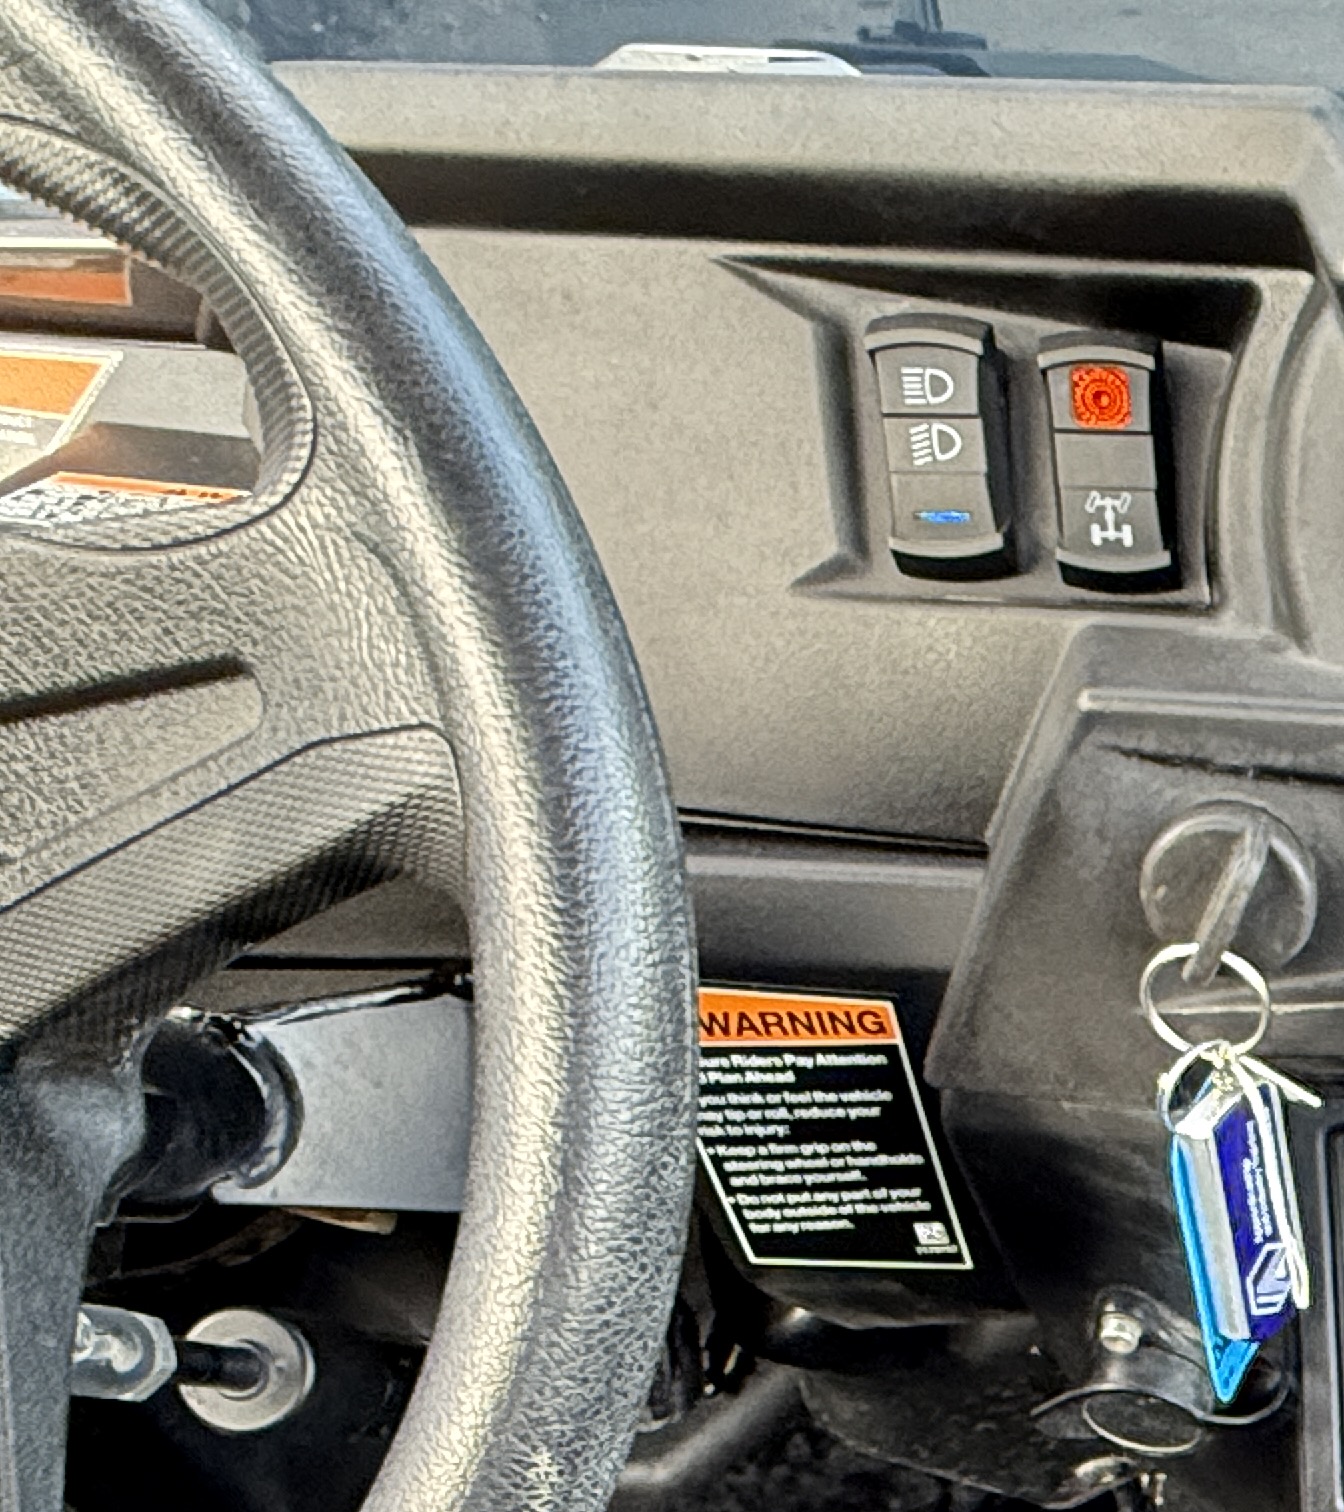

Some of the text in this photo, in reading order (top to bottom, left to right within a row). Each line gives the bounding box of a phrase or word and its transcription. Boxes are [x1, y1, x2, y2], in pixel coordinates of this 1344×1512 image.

[700, 1010, 888, 1037] WARNING
[730, 1054, 784, 1068] Riders
[783, 1053, 814, 1069] Pay
[816, 1052, 888, 1066] Attention
[707, 1071, 743, 1085] Plan
[744, 1070, 796, 1083] Ahead
[726, 1091, 765, 1104] think
[766, 1094, 782, 1104] or
[783, 1091, 812, 1104] feel
[812, 1090, 838, 1102] the
[838, 1089, 893, 1102] vehicle
[794, 1106, 846, 1119] reduce
[847, 1107, 881, 1121] your
[715, 1144, 755, 1157] Keep
[768, 1142, 799, 1154] firm
[800, 1141, 829, 1155] grip
[831, 1142, 850, 1152] on
[851, 1140, 877, 1152] the
[723, 1158, 784, 1171] steering
[785, 1157, 829, 1169] wheel
[846, 1153, 925, 1166] handholds
[729, 1174, 759, 1187] and
[759, 1173, 802, 1185] brace
[736, 1193, 759, 1205] Do
[760, 1192, 785, 1204] not
[786, 1191, 812, 1205] put
[813, 1191, 839, 1203] any
[840, 1188, 871, 1201] part
[888, 1187, 921, 1200] your
[743, 1207, 781, 1220] body
[782, 1205, 837, 1217] outside
[854, 1203, 879, 1214] the
[880, 1201, 931, 1213] vehicle
[749, 1222, 771, 1233] for
[772, 1222, 799, 1235] any
